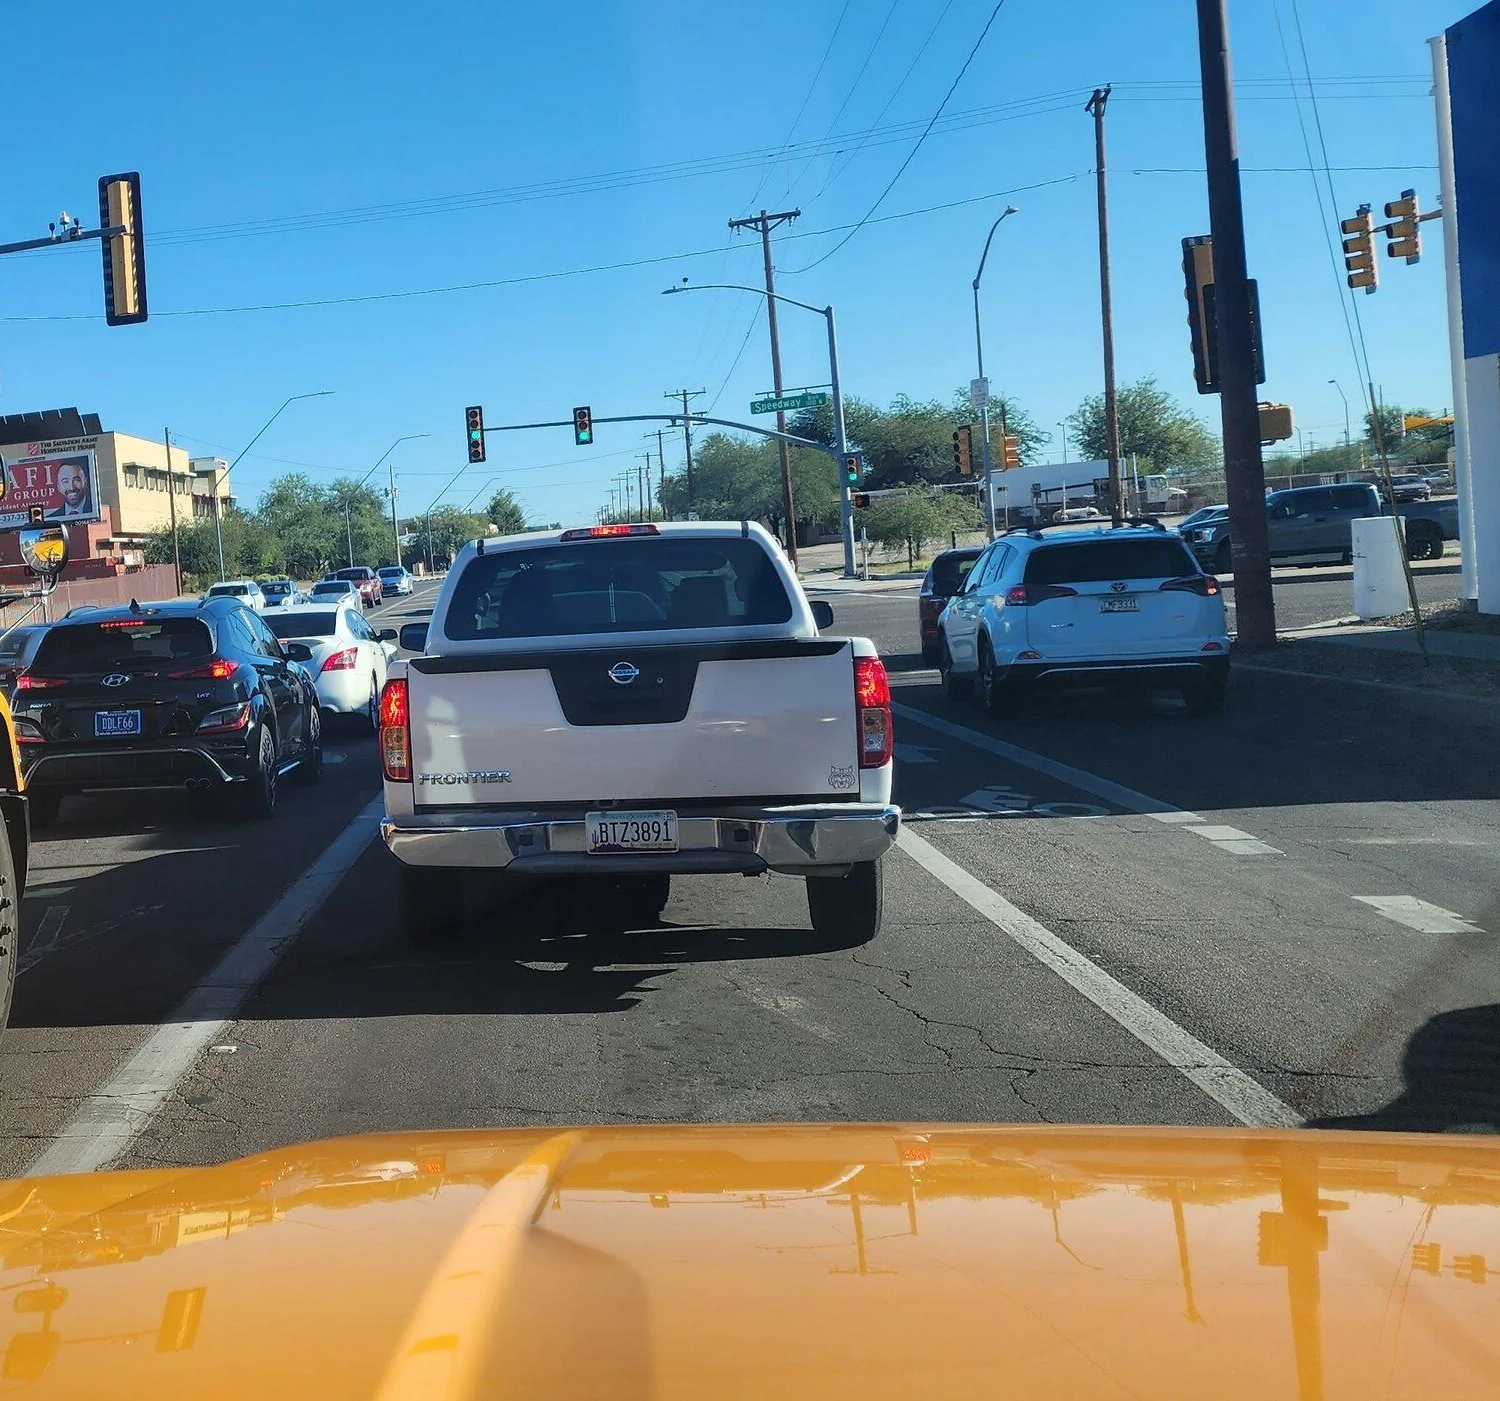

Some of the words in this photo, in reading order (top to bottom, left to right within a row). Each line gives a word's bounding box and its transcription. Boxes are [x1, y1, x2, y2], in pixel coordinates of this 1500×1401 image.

[755, 398, 801, 412] Speedway
[8, 465, 53, 489] AFI
[14, 488, 54, 500] GROUP
[418, 770, 513, 786] FRONTIER
[599, 820, 673, 843] BTZ3891
